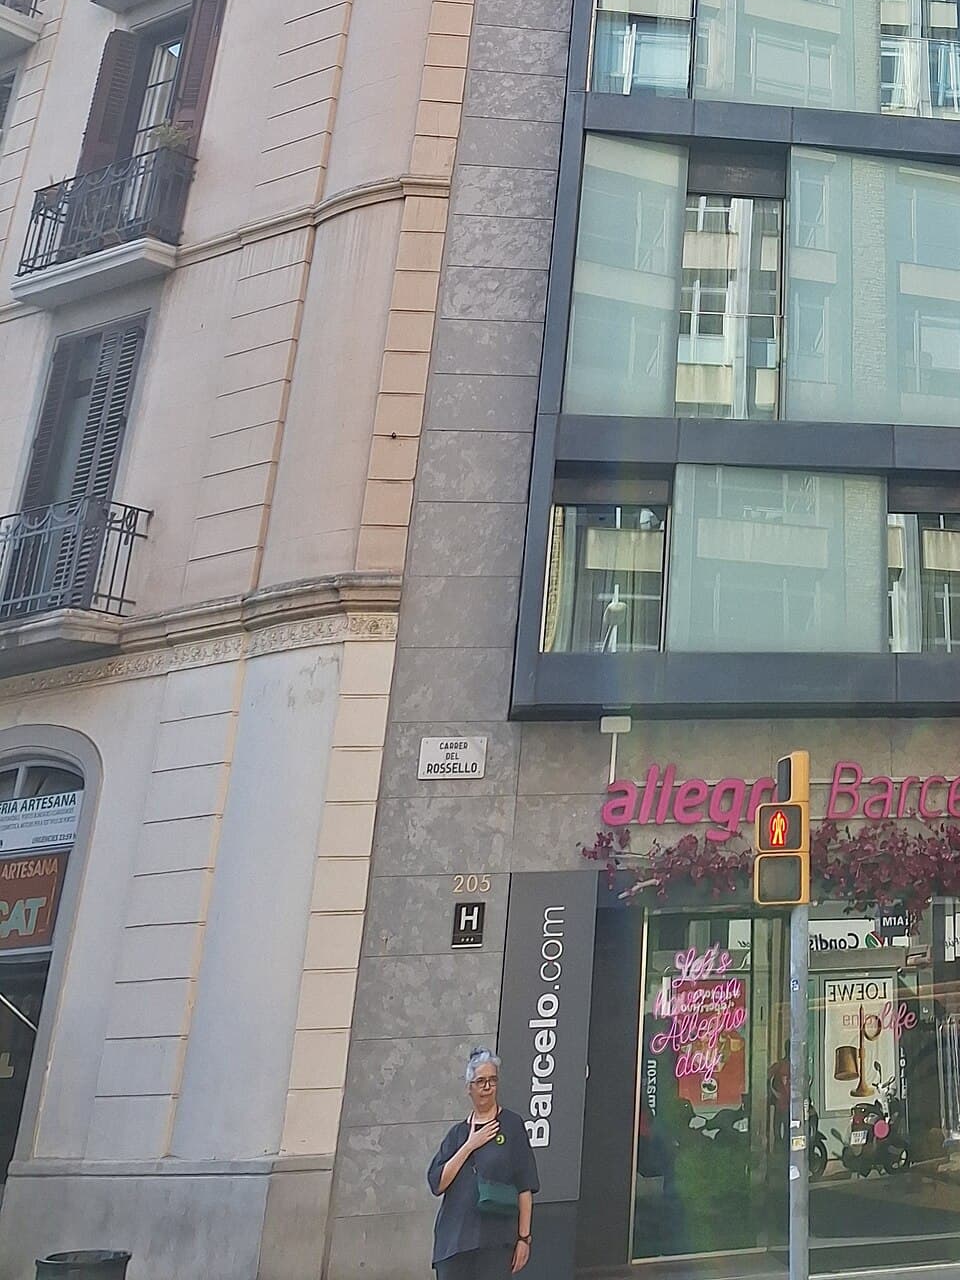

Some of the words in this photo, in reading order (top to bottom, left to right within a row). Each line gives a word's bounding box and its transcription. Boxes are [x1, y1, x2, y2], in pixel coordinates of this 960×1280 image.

[439, 741, 469, 750] CARRER
[445, 752, 460, 761] DEL
[426, 762, 478, 774] ROSSELLO
[19, 793, 77, 812] ARTESANA
[602, 763, 778, 841] allegr
[1, 858, 58, 880] ARTESANA
[452, 874, 492, 893] 205
[460, 906, 479, 931] H
[525, 905, 566, 1148] Barcelo.com
[651, 1007, 747, 1054] Allegro
[675, 1049, 723, 1082] day
